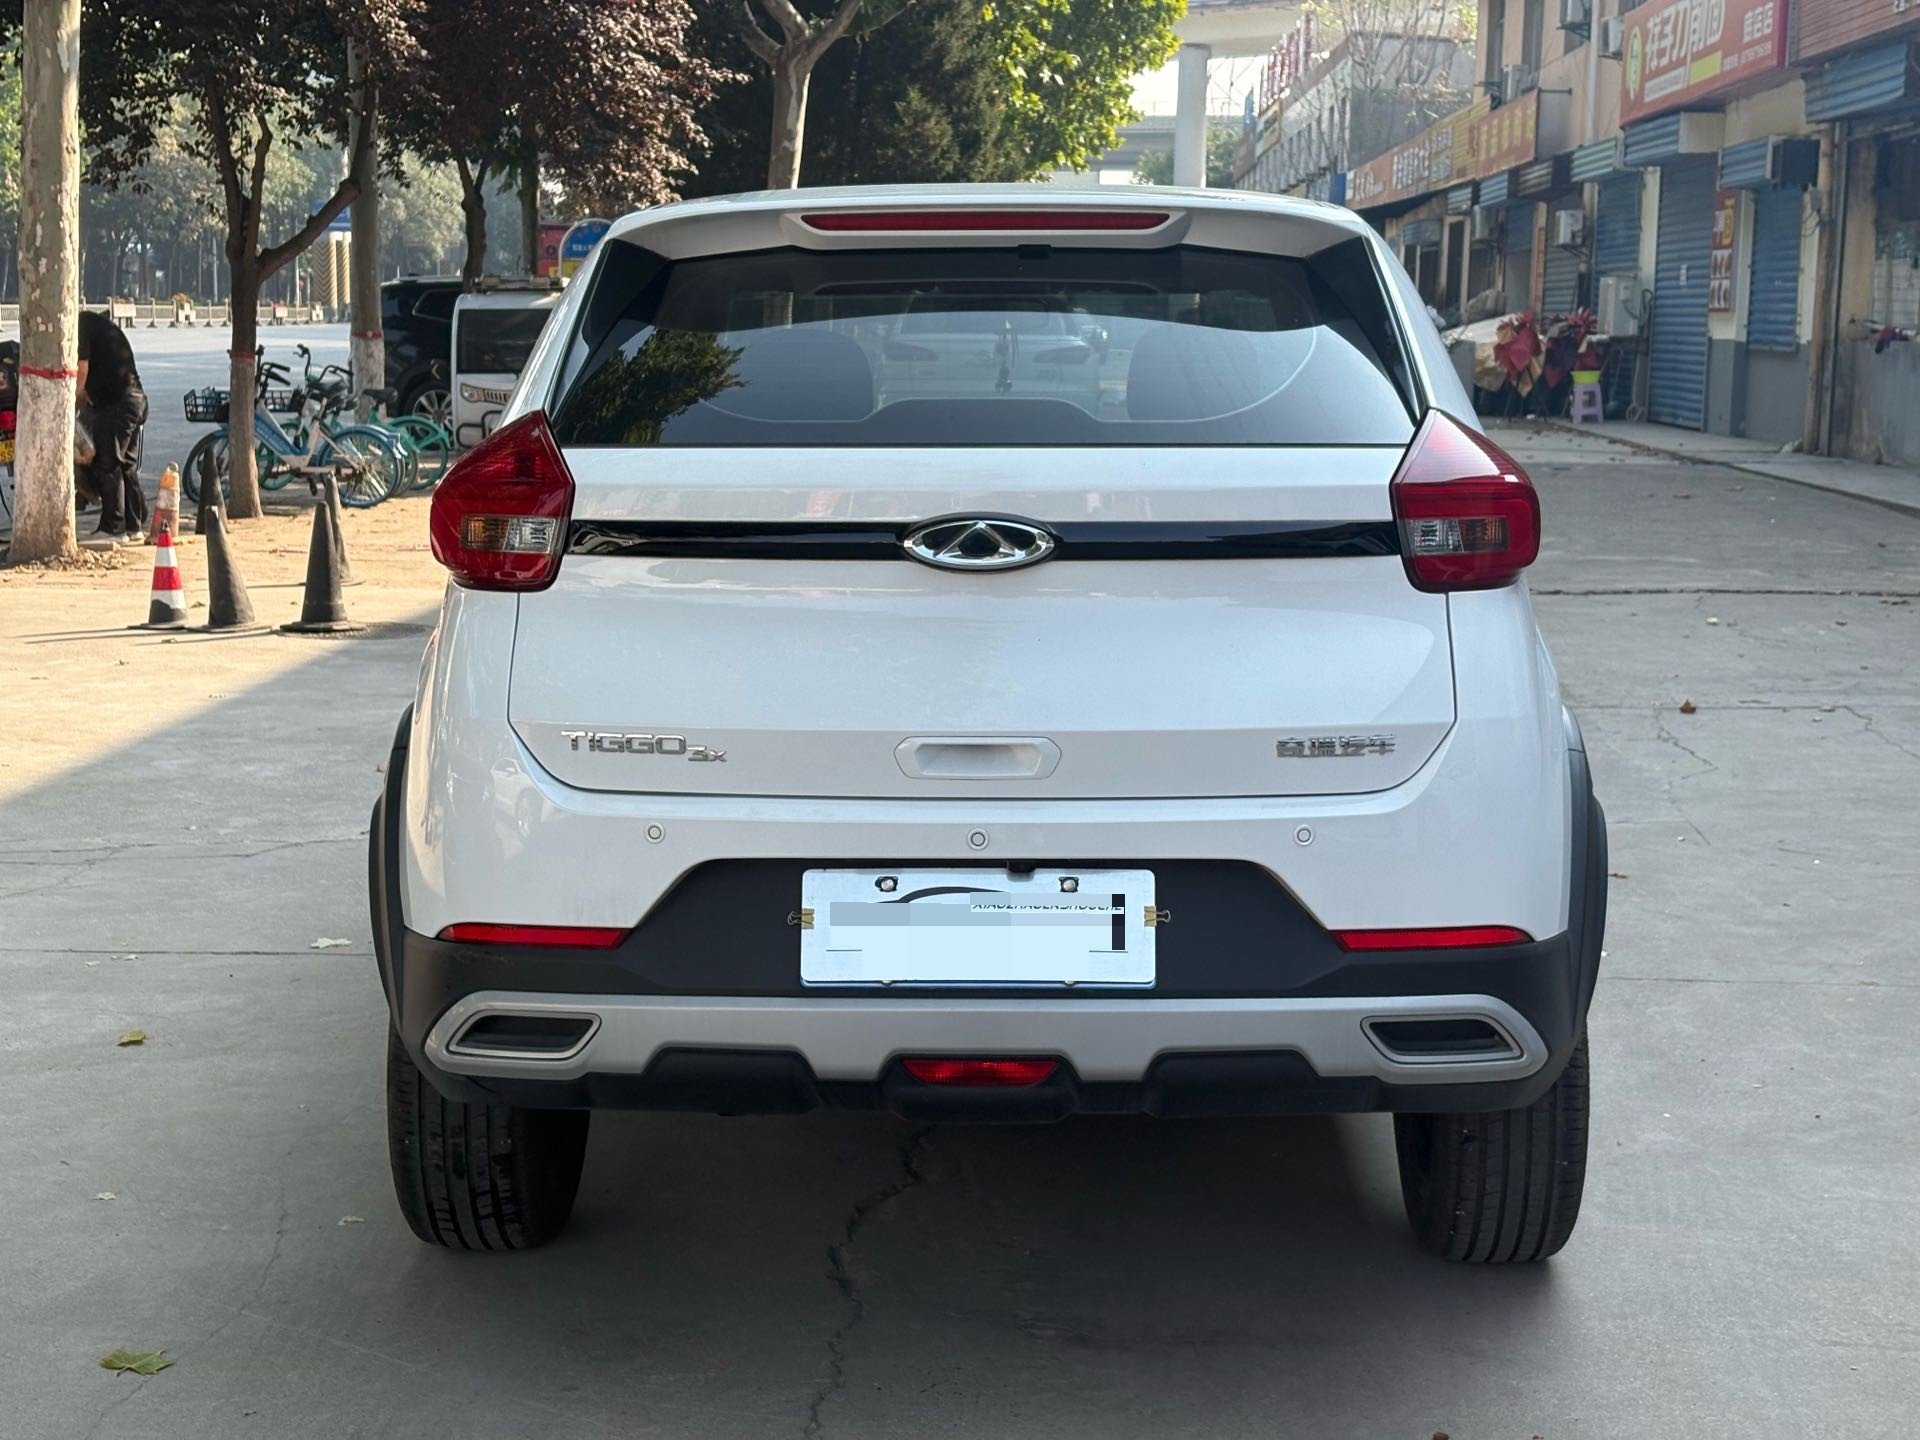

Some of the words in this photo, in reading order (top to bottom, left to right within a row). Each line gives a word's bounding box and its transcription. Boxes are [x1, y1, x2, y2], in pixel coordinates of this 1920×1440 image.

[561, 730, 687, 755] TIGGO
[1276, 735, 1395, 758] 奇瑞汽车
